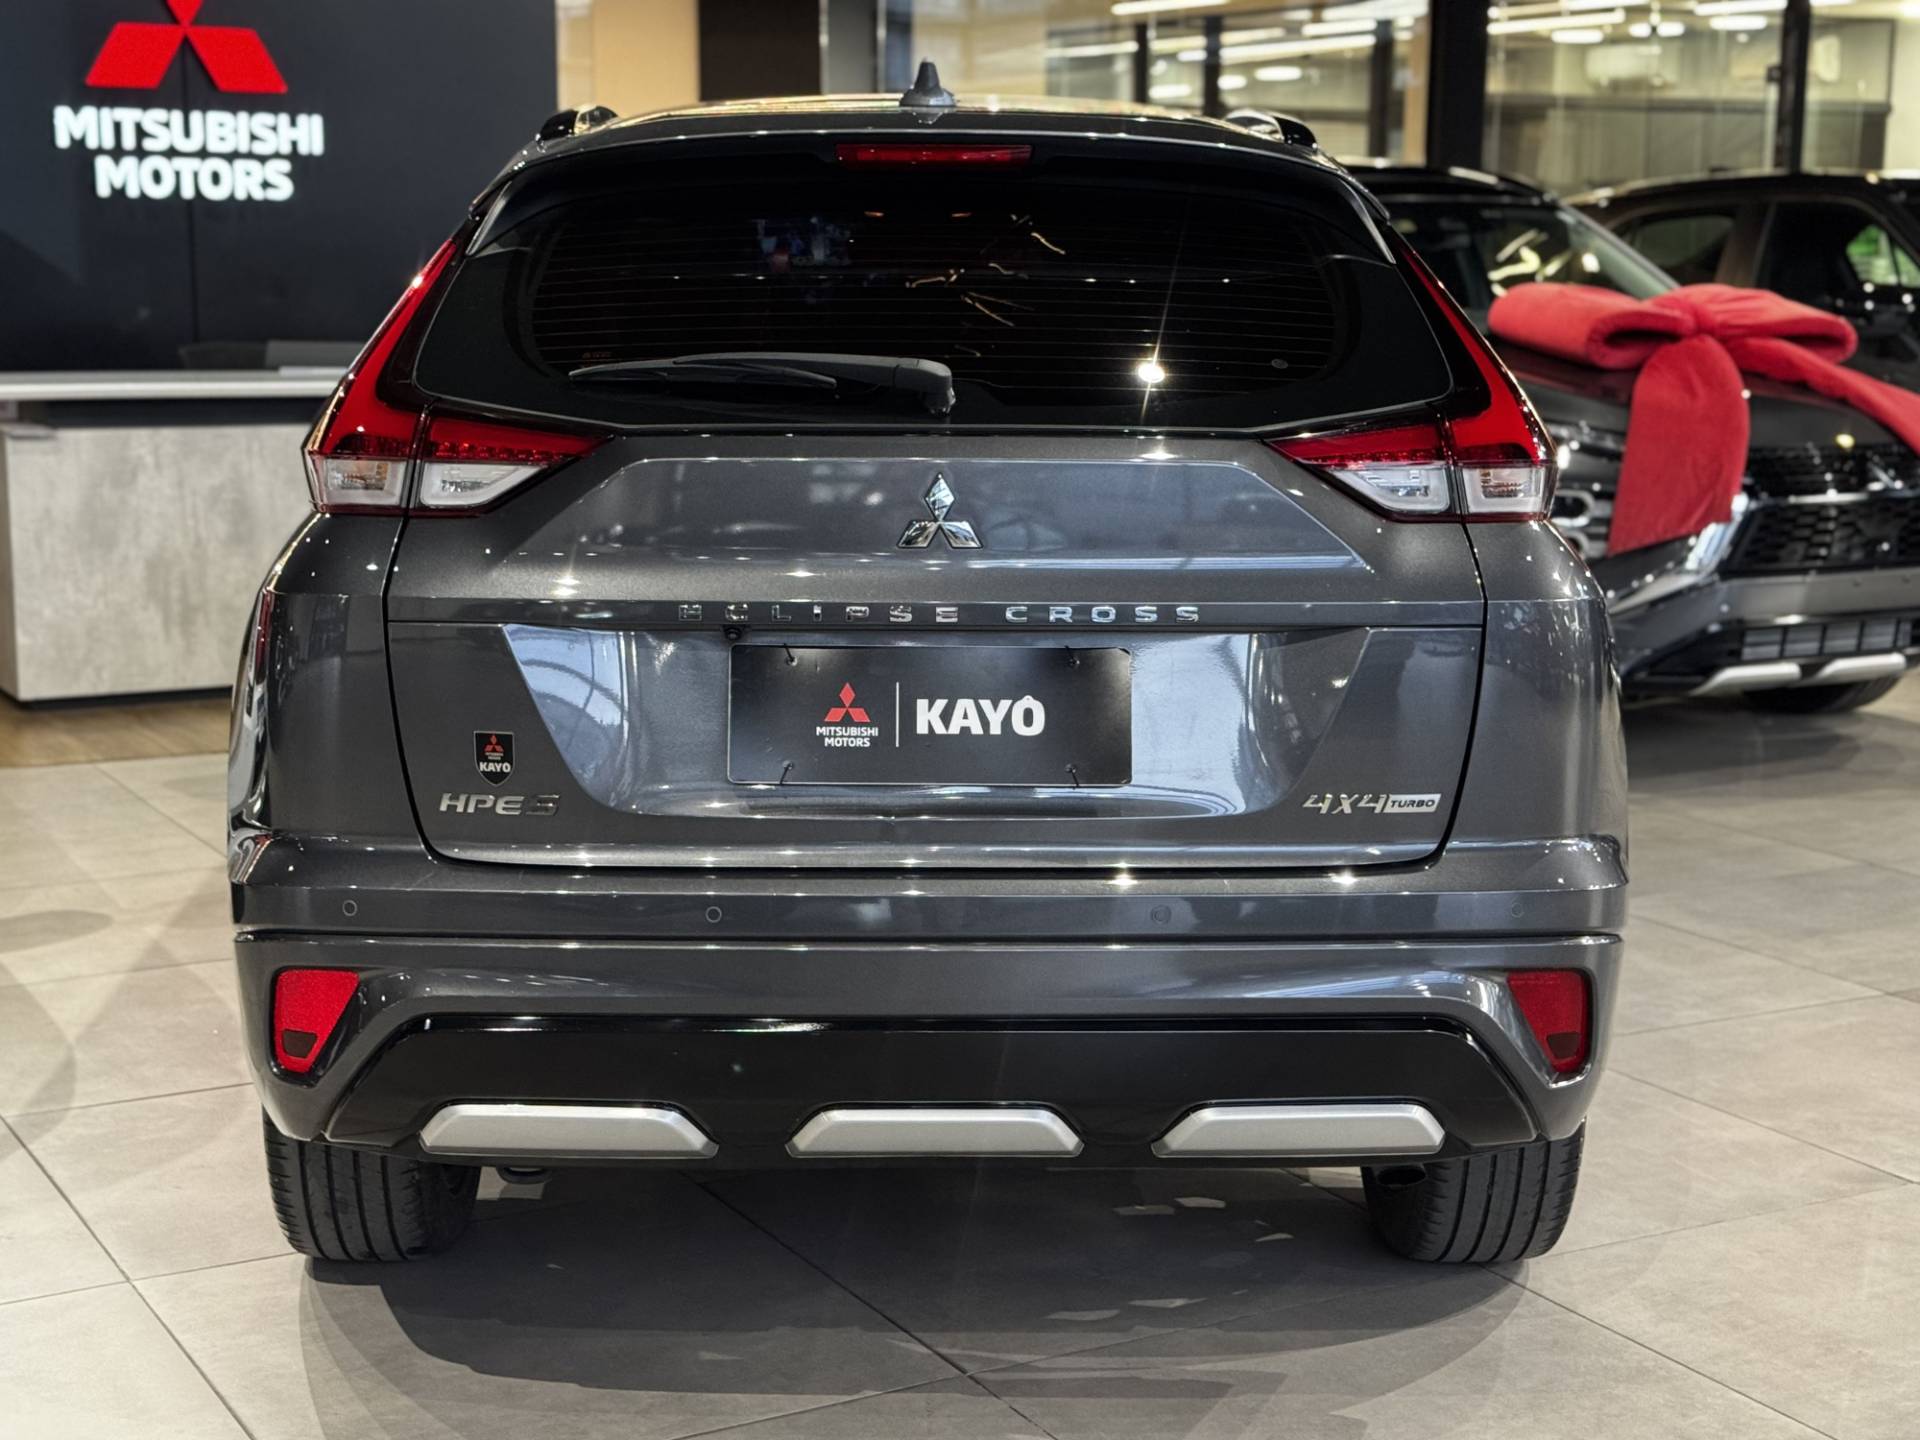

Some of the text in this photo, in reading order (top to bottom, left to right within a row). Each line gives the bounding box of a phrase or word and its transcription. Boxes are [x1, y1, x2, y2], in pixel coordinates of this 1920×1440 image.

[53, 105, 325, 156] MITSUBISHI
[94, 154, 295, 201] MOTORS
[1004, 605, 1200, 623] CROSS
[815, 726, 879, 737] MITSUBISHI
[824, 737, 871, 748] MOTORS
[1389, 798, 1437, 809] TURBO
